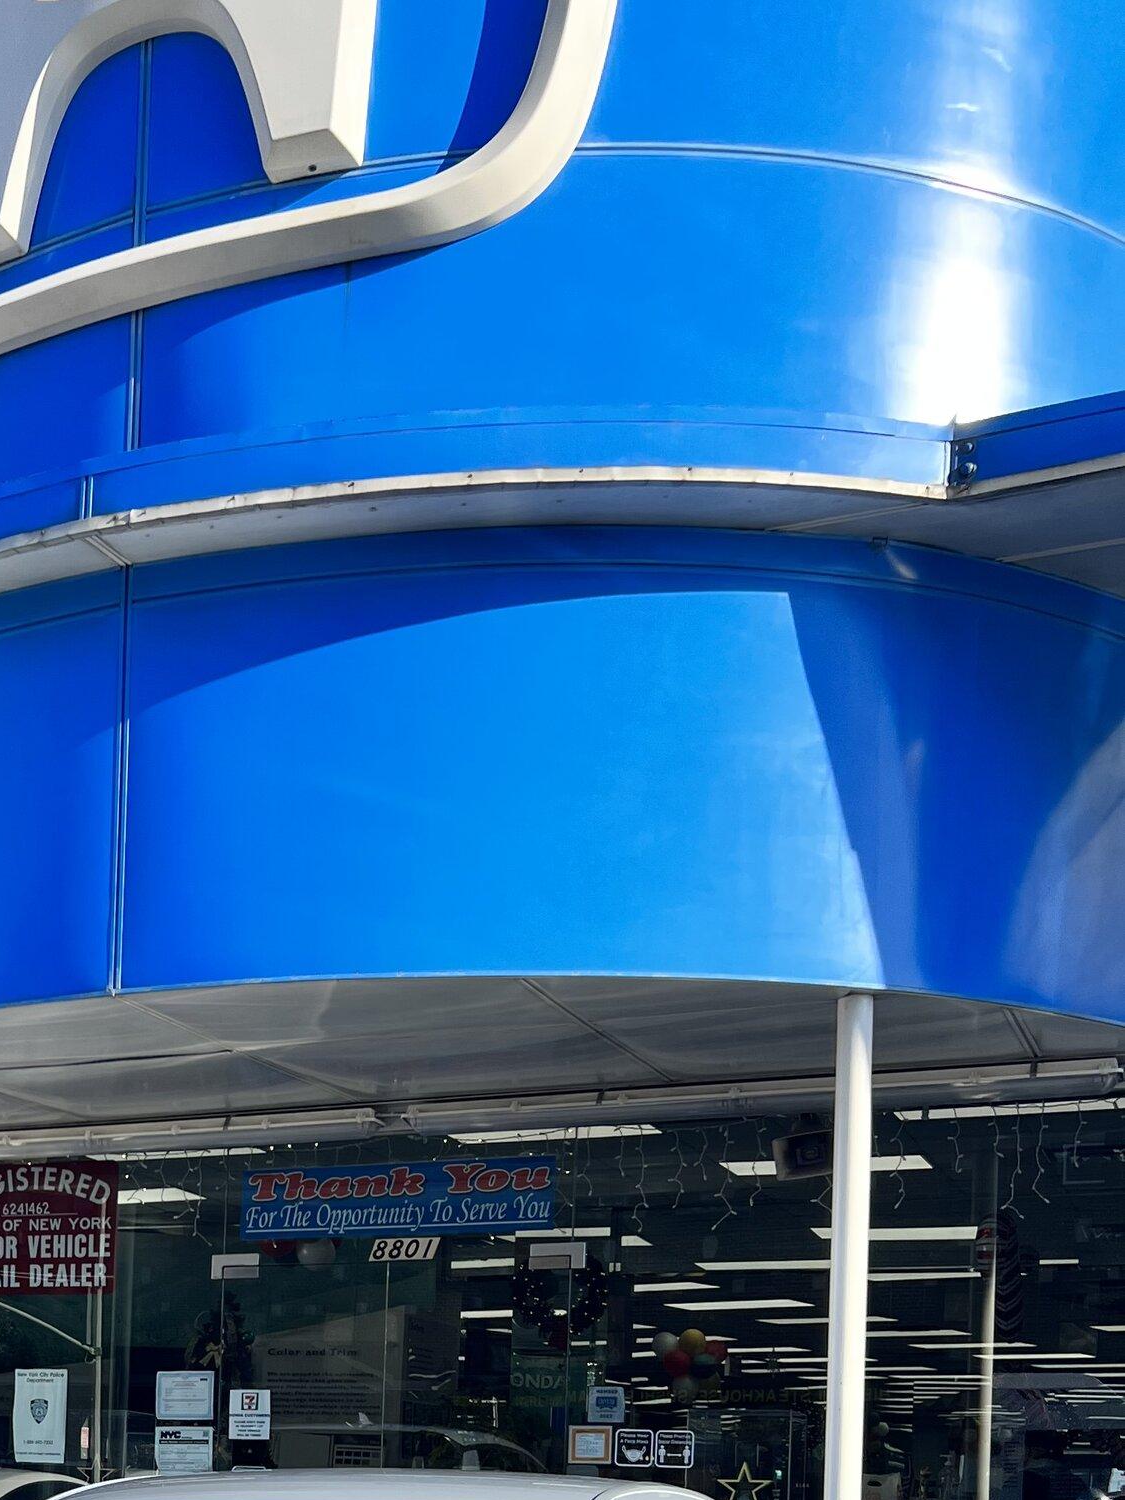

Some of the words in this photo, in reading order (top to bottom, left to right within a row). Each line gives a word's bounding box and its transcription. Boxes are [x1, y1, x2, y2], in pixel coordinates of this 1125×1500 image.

[248, 1166, 426, 1202] Thank
[442, 1162, 551, 1194] You
[2, 1201, 50, 1216] 6241462
[245, 1206, 277, 1229] For
[280, 1202, 310, 1228] The
[316, 1199, 425, 1235] Opportunity
[429, 1197, 452, 1223] To
[456, 1197, 507, 1225] Serve
[513, 1193, 551, 1220] You
[2, 1218, 23, 1232] OF
[29, 1217, 62, 1231] NEW
[68, 1216, 112, 1230] YORK
[27, 1233, 111, 1259] VEHICLE
[372, 1238, 434, 1259] 8801
[29, 1262, 107, 1288] DEALER
[267, 1347, 302, 1357] Color
[305, 1347, 326, 1357] and
[160, 1430, 181, 1439] NYC
